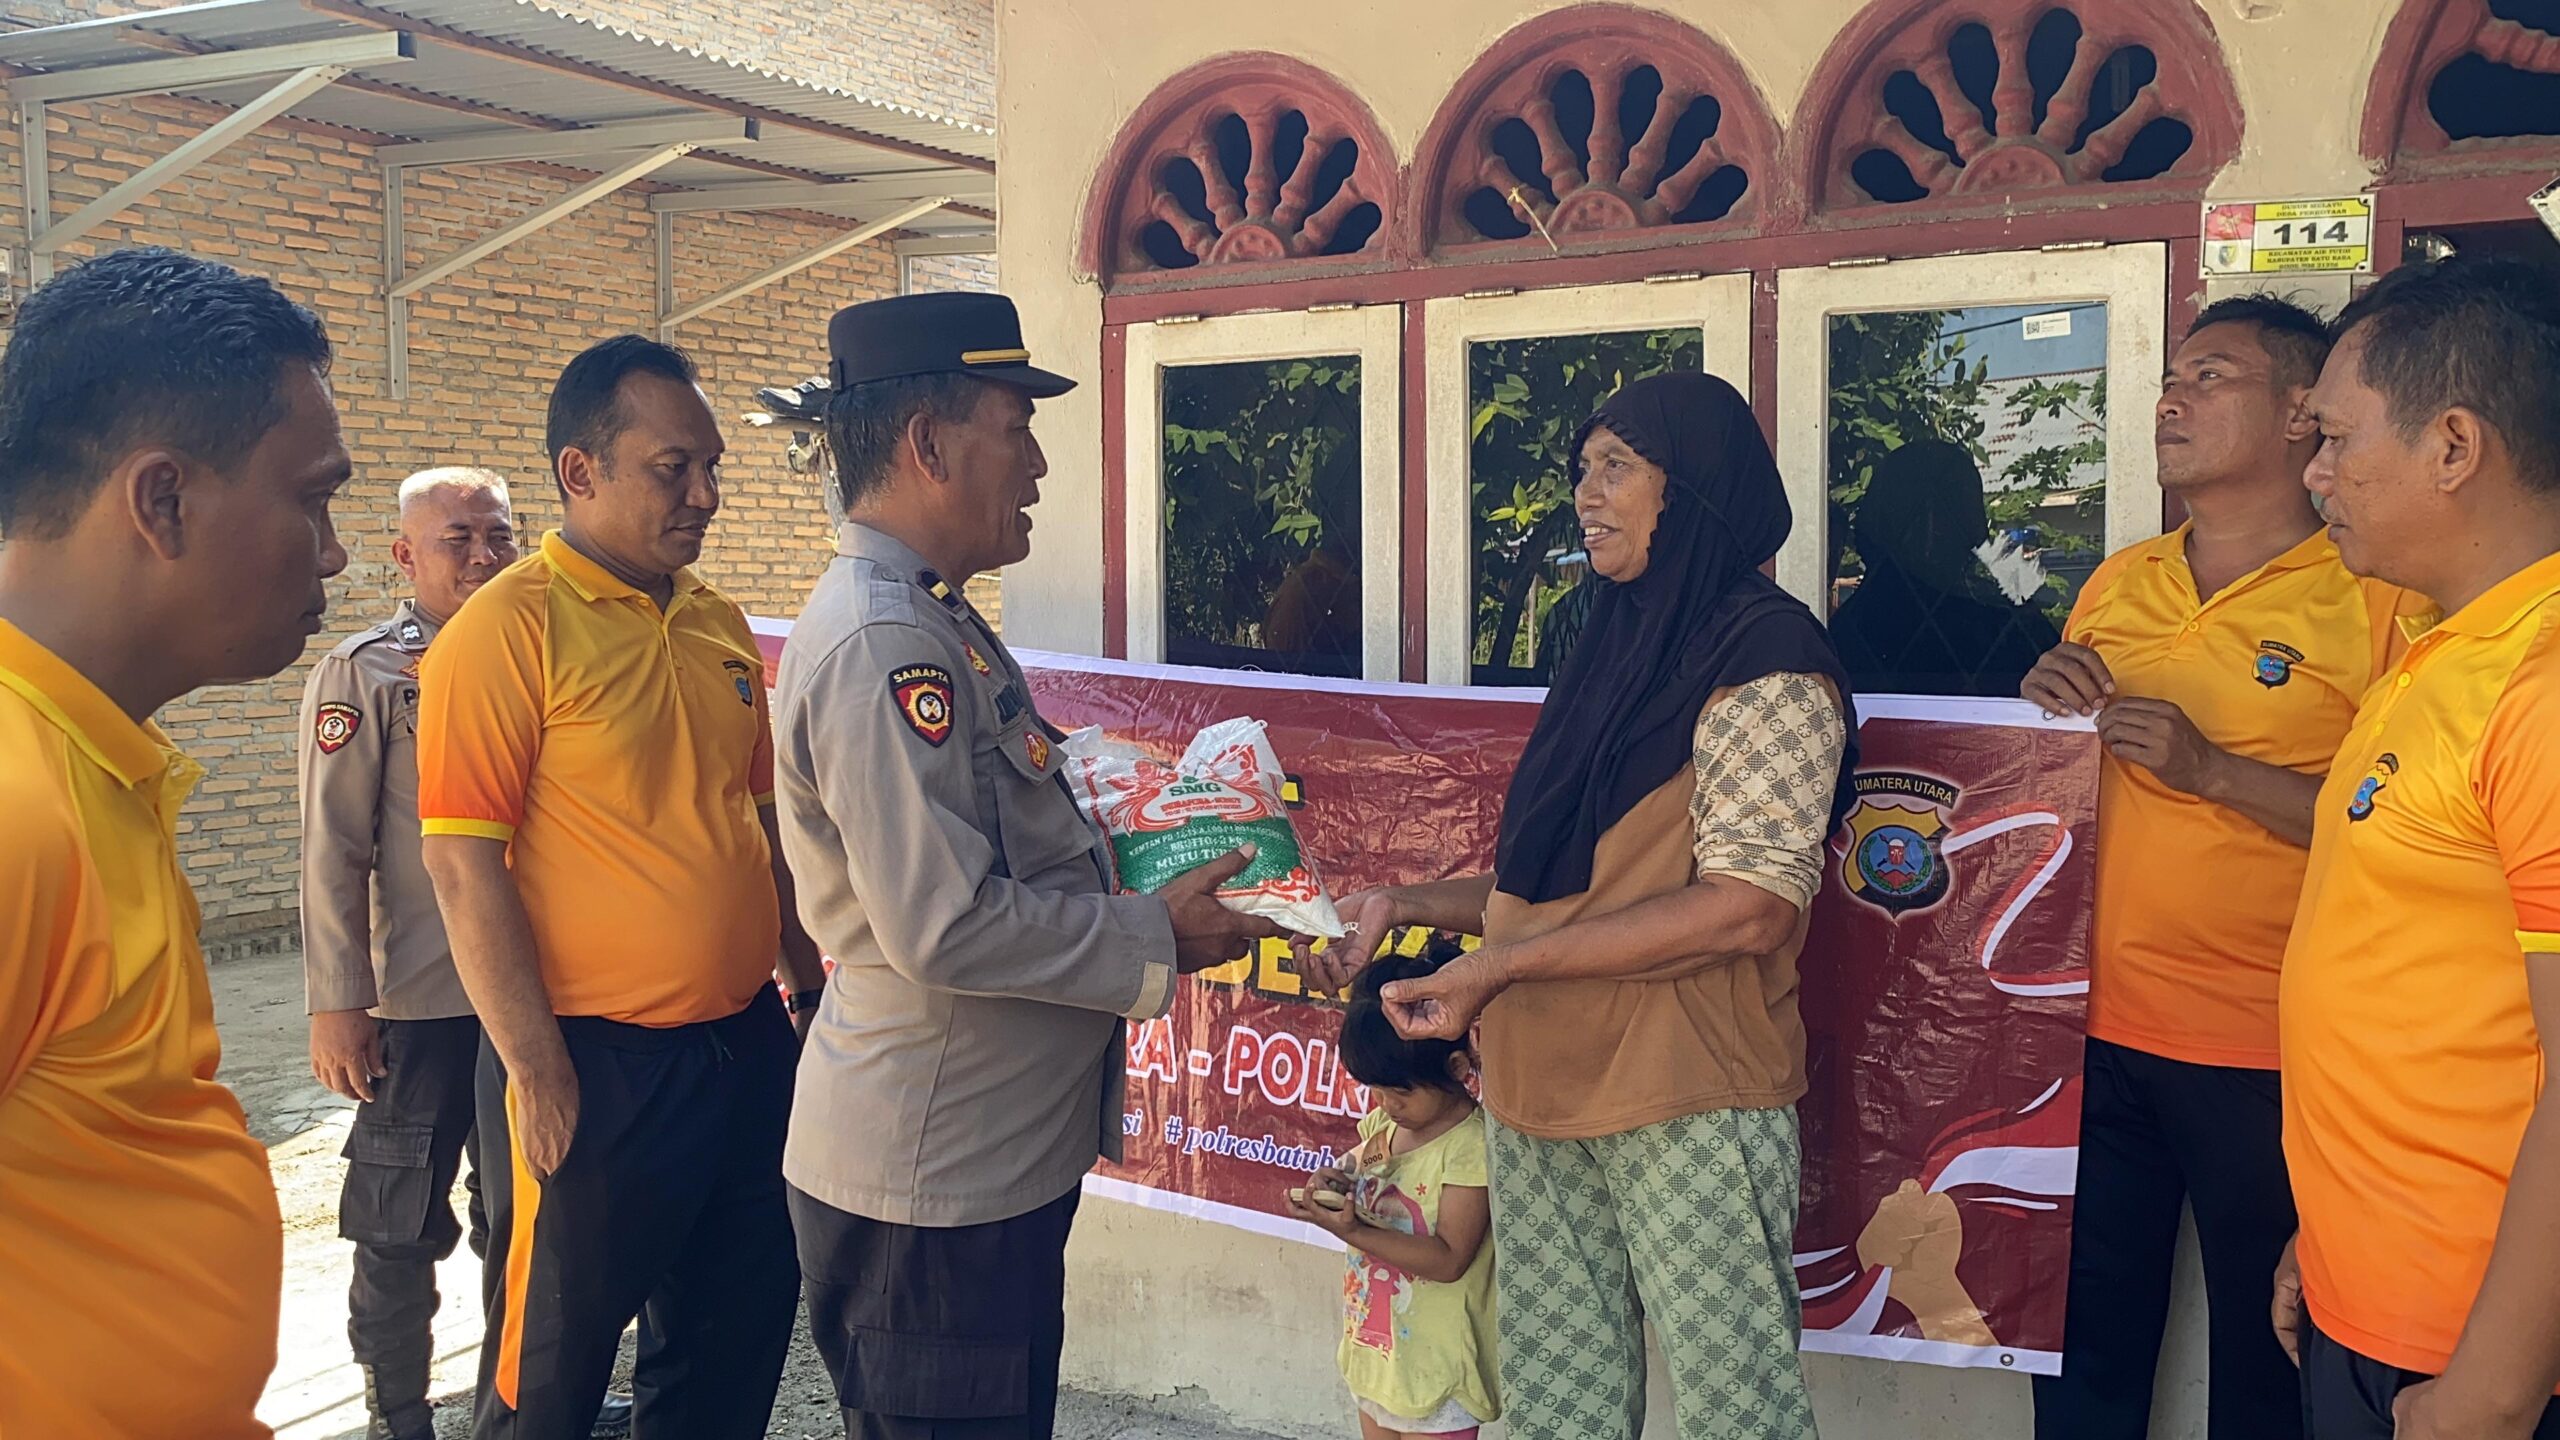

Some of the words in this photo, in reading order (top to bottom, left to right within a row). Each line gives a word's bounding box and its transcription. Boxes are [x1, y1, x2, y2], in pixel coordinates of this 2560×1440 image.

[2273, 221, 2348, 245] 114
[892, 667, 949, 684] SAMAPTA
[1168, 782, 1222, 797] SMG
[1854, 777, 1911, 792] UMATERA
[1913, 780, 1953, 804] UTARA
[1155, 850, 1199, 871] MUTU
[1126, 1013, 1177, 1083] RA
[1224, 1025, 1378, 1120] POLR
[1123, 1108, 1143, 1135] si
[1362, 1153, 1384, 1168] 5000
